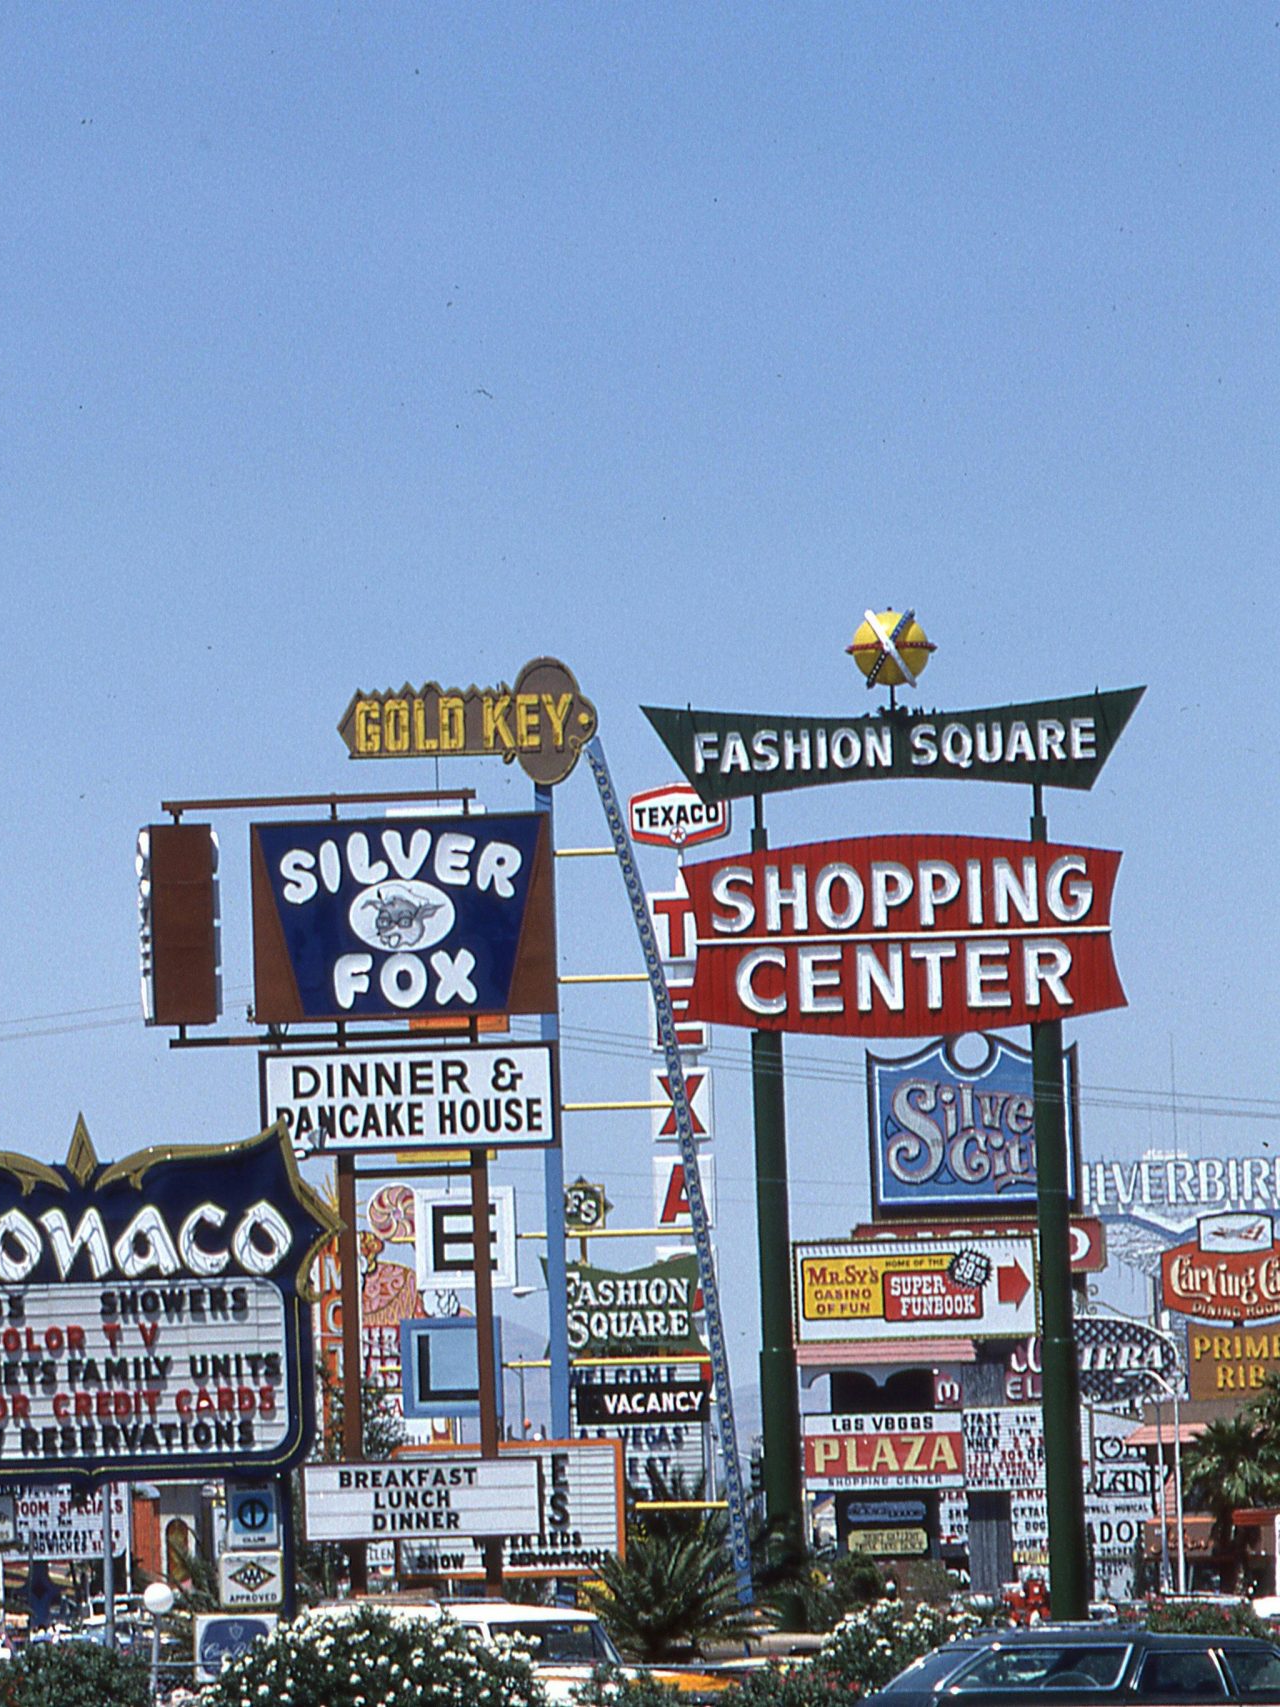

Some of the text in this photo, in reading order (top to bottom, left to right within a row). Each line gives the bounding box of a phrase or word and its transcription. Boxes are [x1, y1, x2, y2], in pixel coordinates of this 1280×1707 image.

[355, 693, 572, 753] GOLD KEY
[694, 718, 1097, 774] FASHION SQUARE
[634, 803, 720, 828] TEXACO
[279, 828, 523, 905] SILVER
[711, 855, 1093, 934] SHOPPING
[333, 948, 478, 1009] FOX
[735, 938, 1074, 1016] CENTER
[291, 1056, 524, 1100] DINNER &
[275, 1097, 544, 1141] PANCAKE HOUSE
[888, 1078, 1035, 1185] Silve
[949, 1128, 1038, 1194] Cit
[885, 1257, 945, 1268] HOME OF THE
[566, 1271, 690, 1307] FASHION
[814, 1288, 872, 1300] CASINO
[890, 1275, 948, 1297] SUPER
[1170, 1254, 1259, 1306] Carving
[100, 1287, 248, 1317] SHOWERS
[816, 1302, 871, 1315] OF FUN
[900, 1295, 976, 1317] FUNBOOK
[1192, 1302, 1241, 1317] DINING
[568, 1310, 690, 1347] SQUARE
[67, 1356, 172, 1384] FAMILY
[189, 1352, 282, 1380] UNITS
[1216, 1363, 1266, 1389] RIB
[53, 1389, 162, 1417] CREDIT
[176, 1387, 276, 1414] CARDS
[604, 1391, 704, 1414] VACANCY
[20, 1421, 255, 1454] RESERVATIONS
[814, 1435, 959, 1474] PLAZA
[338, 1467, 477, 1489] BREAKFAST
[828, 1475, 942, 1487] SHOPPING CENTER
[373, 1491, 451, 1510] LUNCH
[372, 1513, 461, 1532] DINNER
[417, 1553, 465, 1570] SHOW
[229, 1593, 278, 1603] APPROVED
